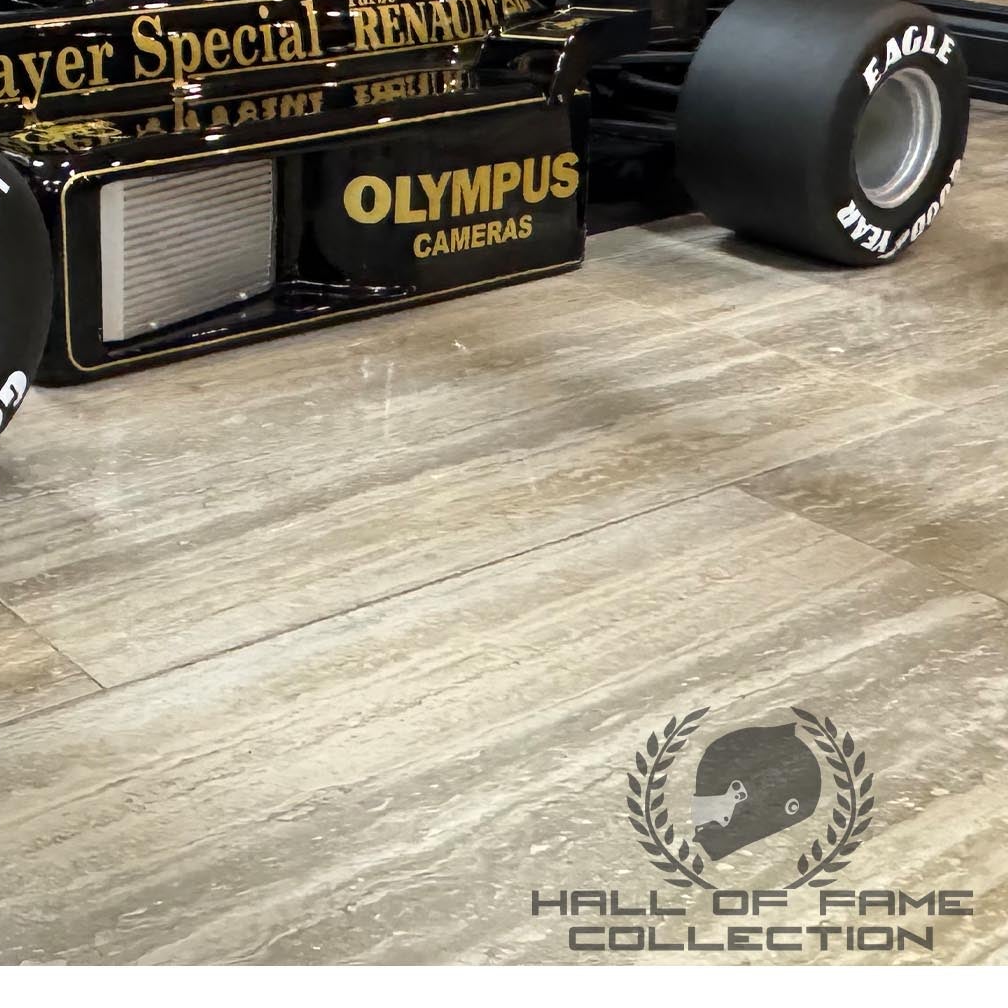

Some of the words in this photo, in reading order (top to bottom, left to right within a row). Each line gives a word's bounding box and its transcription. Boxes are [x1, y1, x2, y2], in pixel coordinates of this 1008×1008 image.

[132, 0, 323, 84] Special
[862, 24, 956, 94] EAGLE
[343, 151, 580, 224] OLYMPUS
[412, 214, 534, 259] CAMERAS
